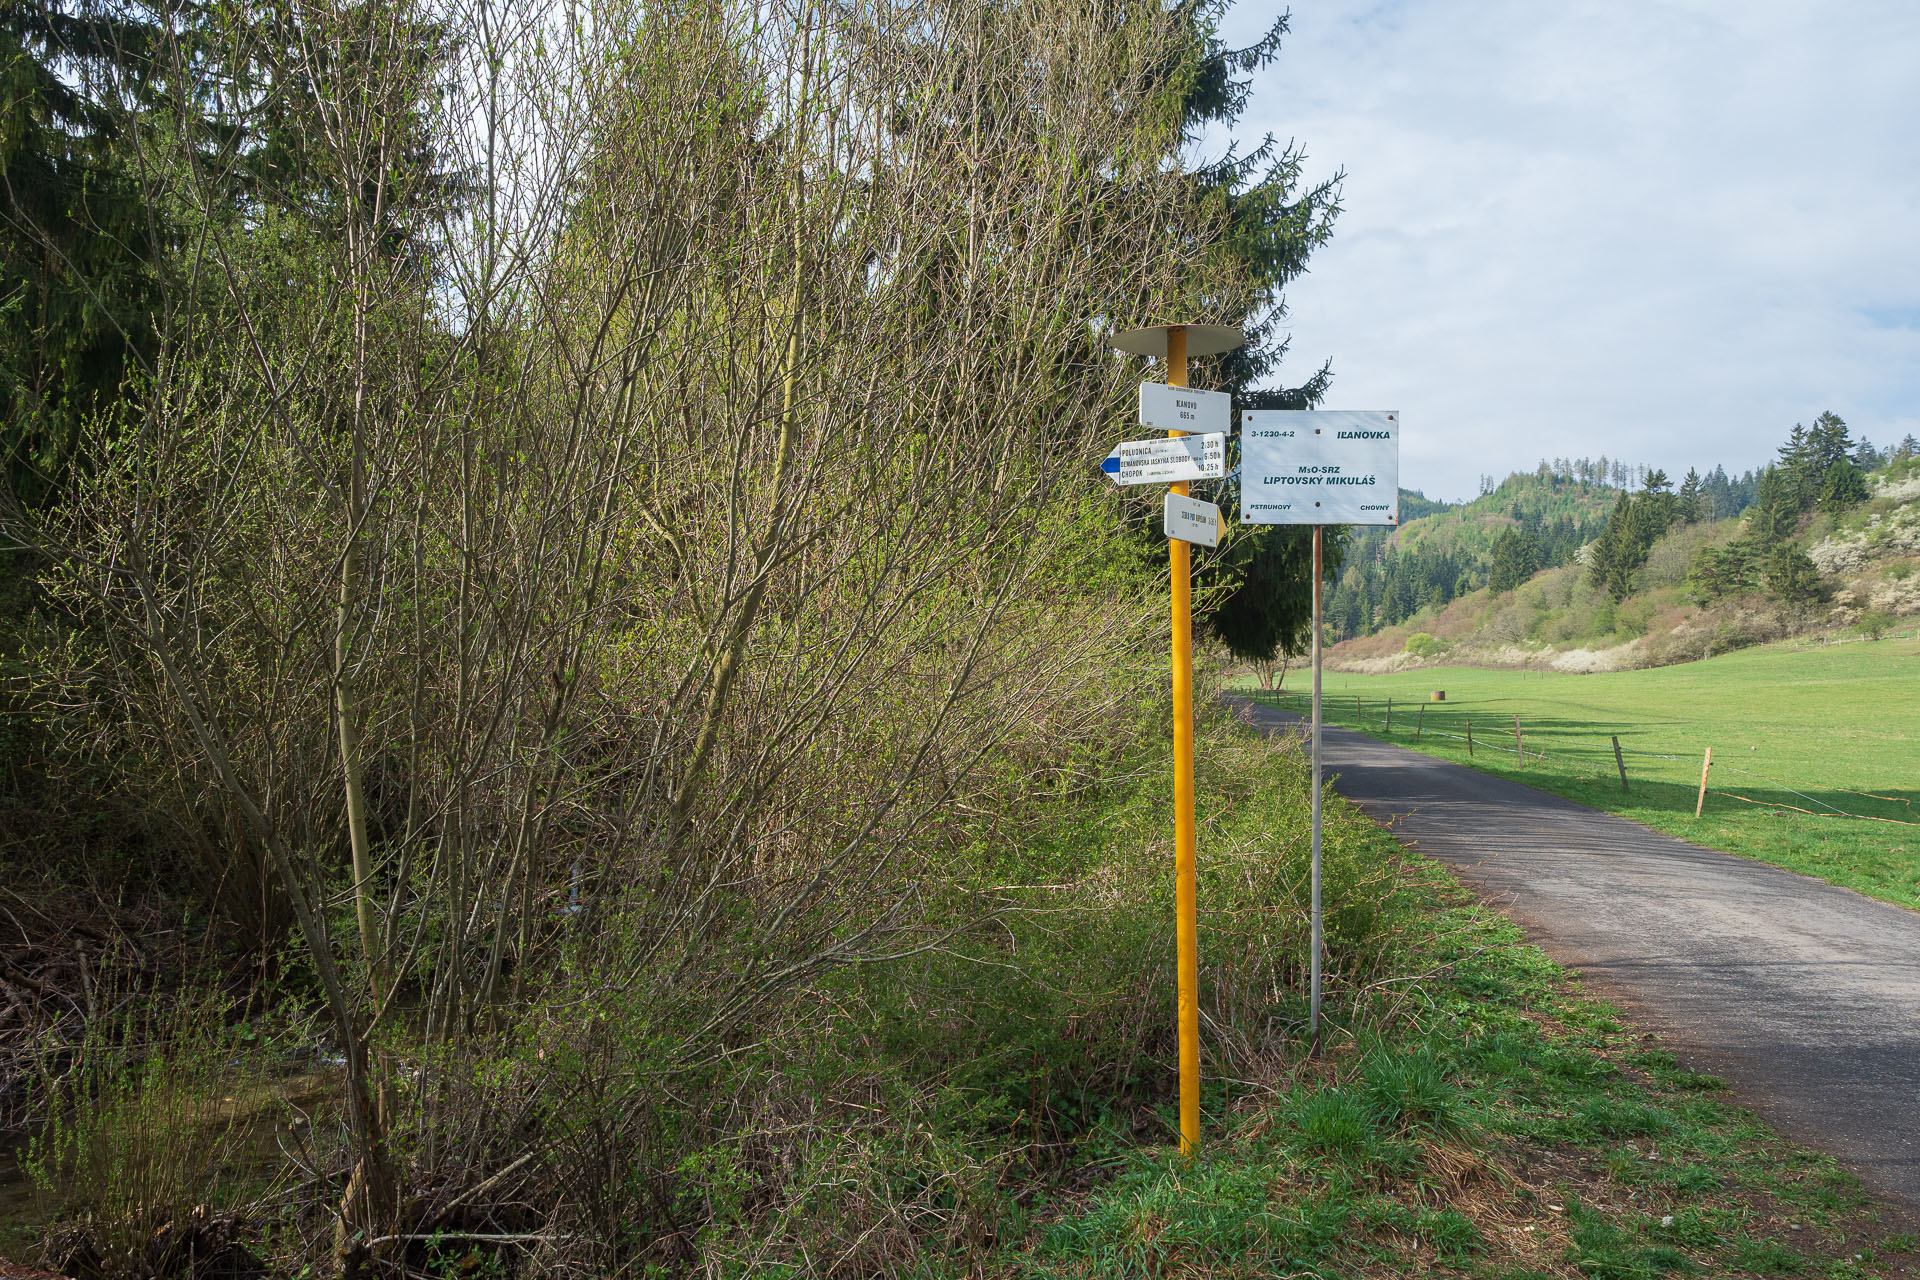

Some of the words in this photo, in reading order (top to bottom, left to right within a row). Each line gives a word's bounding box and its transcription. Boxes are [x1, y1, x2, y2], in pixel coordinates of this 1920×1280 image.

[1251, 430, 1295, 438] 3-1230-4-2
[1337, 431, 1390, 439] IĽANOVKA
[1121, 469, 1143, 478] CHOPOK
[1263, 475, 1324, 485] LIPTOVSKÝ
[1326, 475, 1376, 485] MIKULÁŠ
